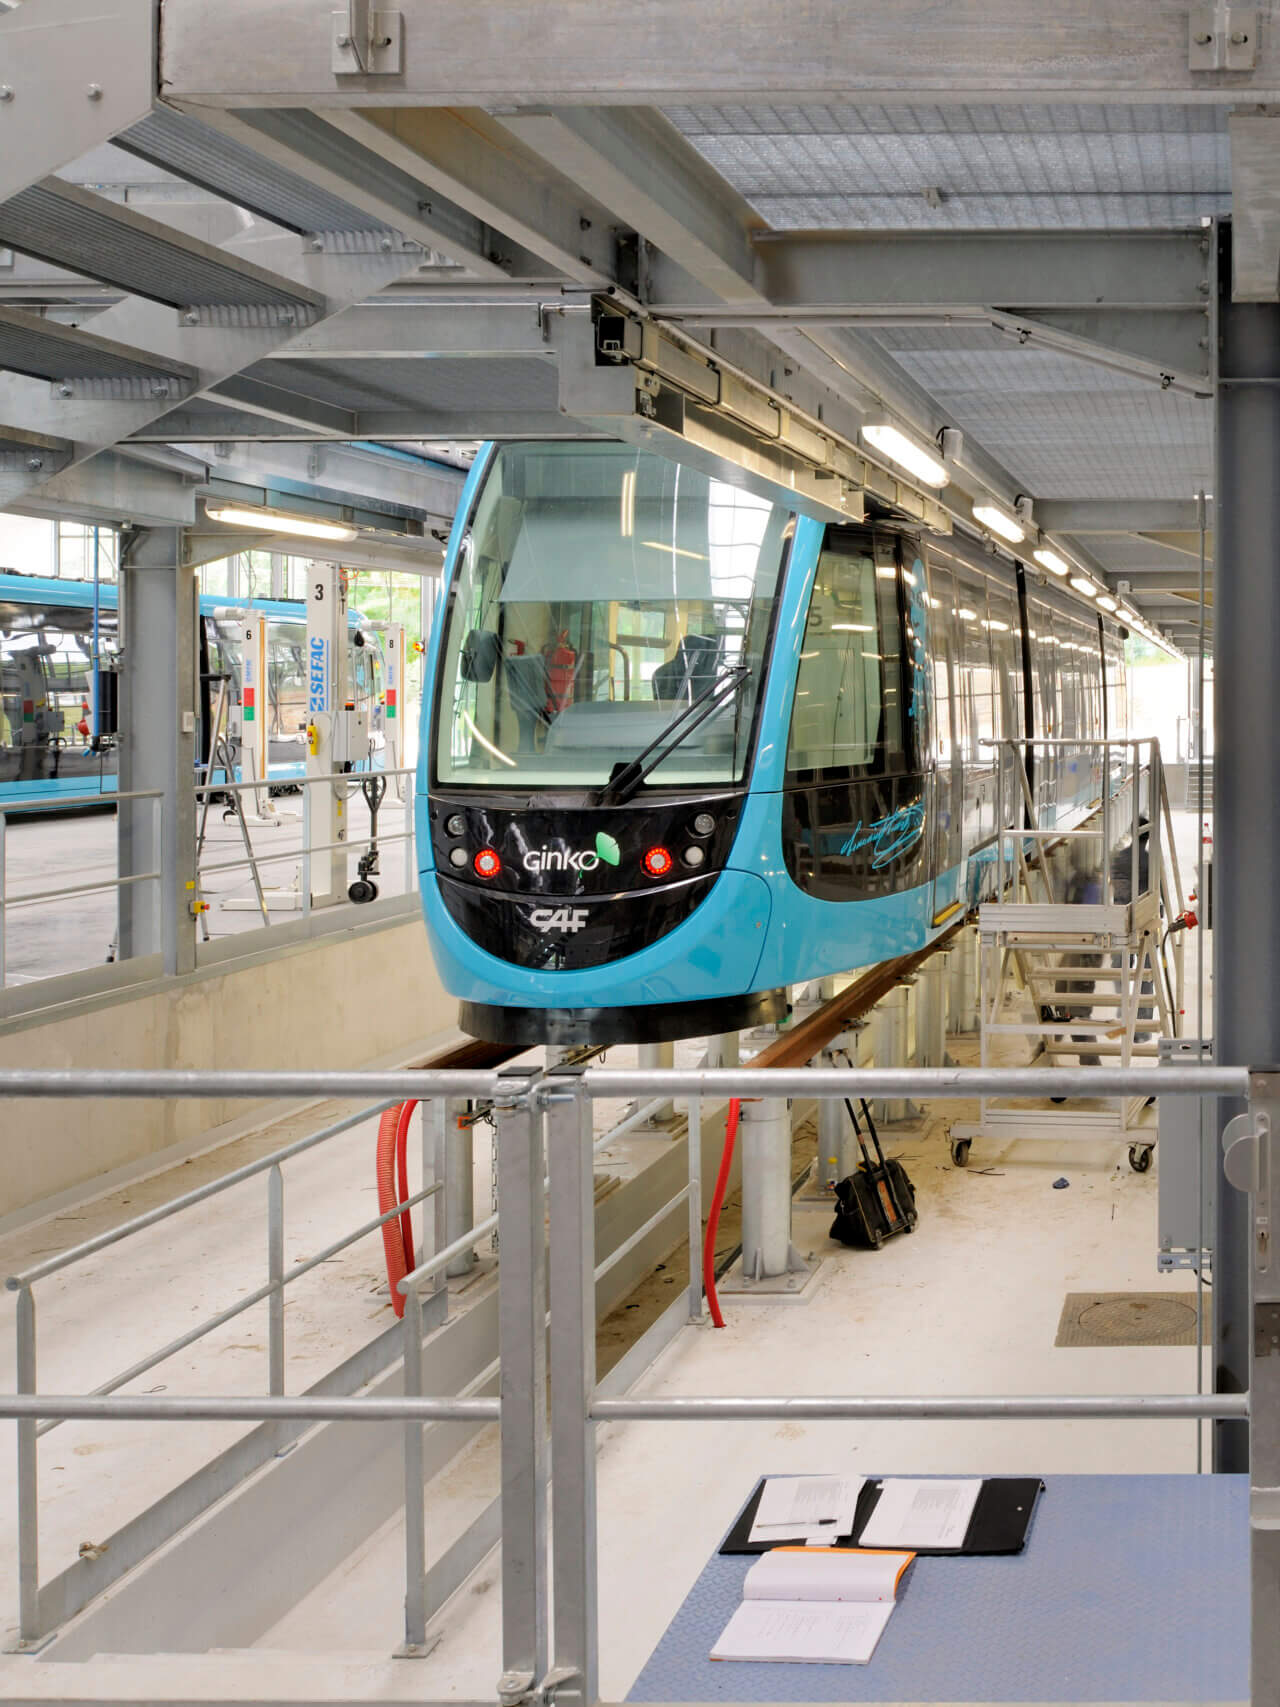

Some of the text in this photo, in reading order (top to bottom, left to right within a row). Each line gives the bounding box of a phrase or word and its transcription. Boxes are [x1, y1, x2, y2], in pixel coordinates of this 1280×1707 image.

[315, 584, 324, 600] 3
[246, 630, 252, 640] 6
[389, 639, 394, 649] 8
[310, 636, 325, 696] SEFAC
[529, 909, 589, 933] CAF
